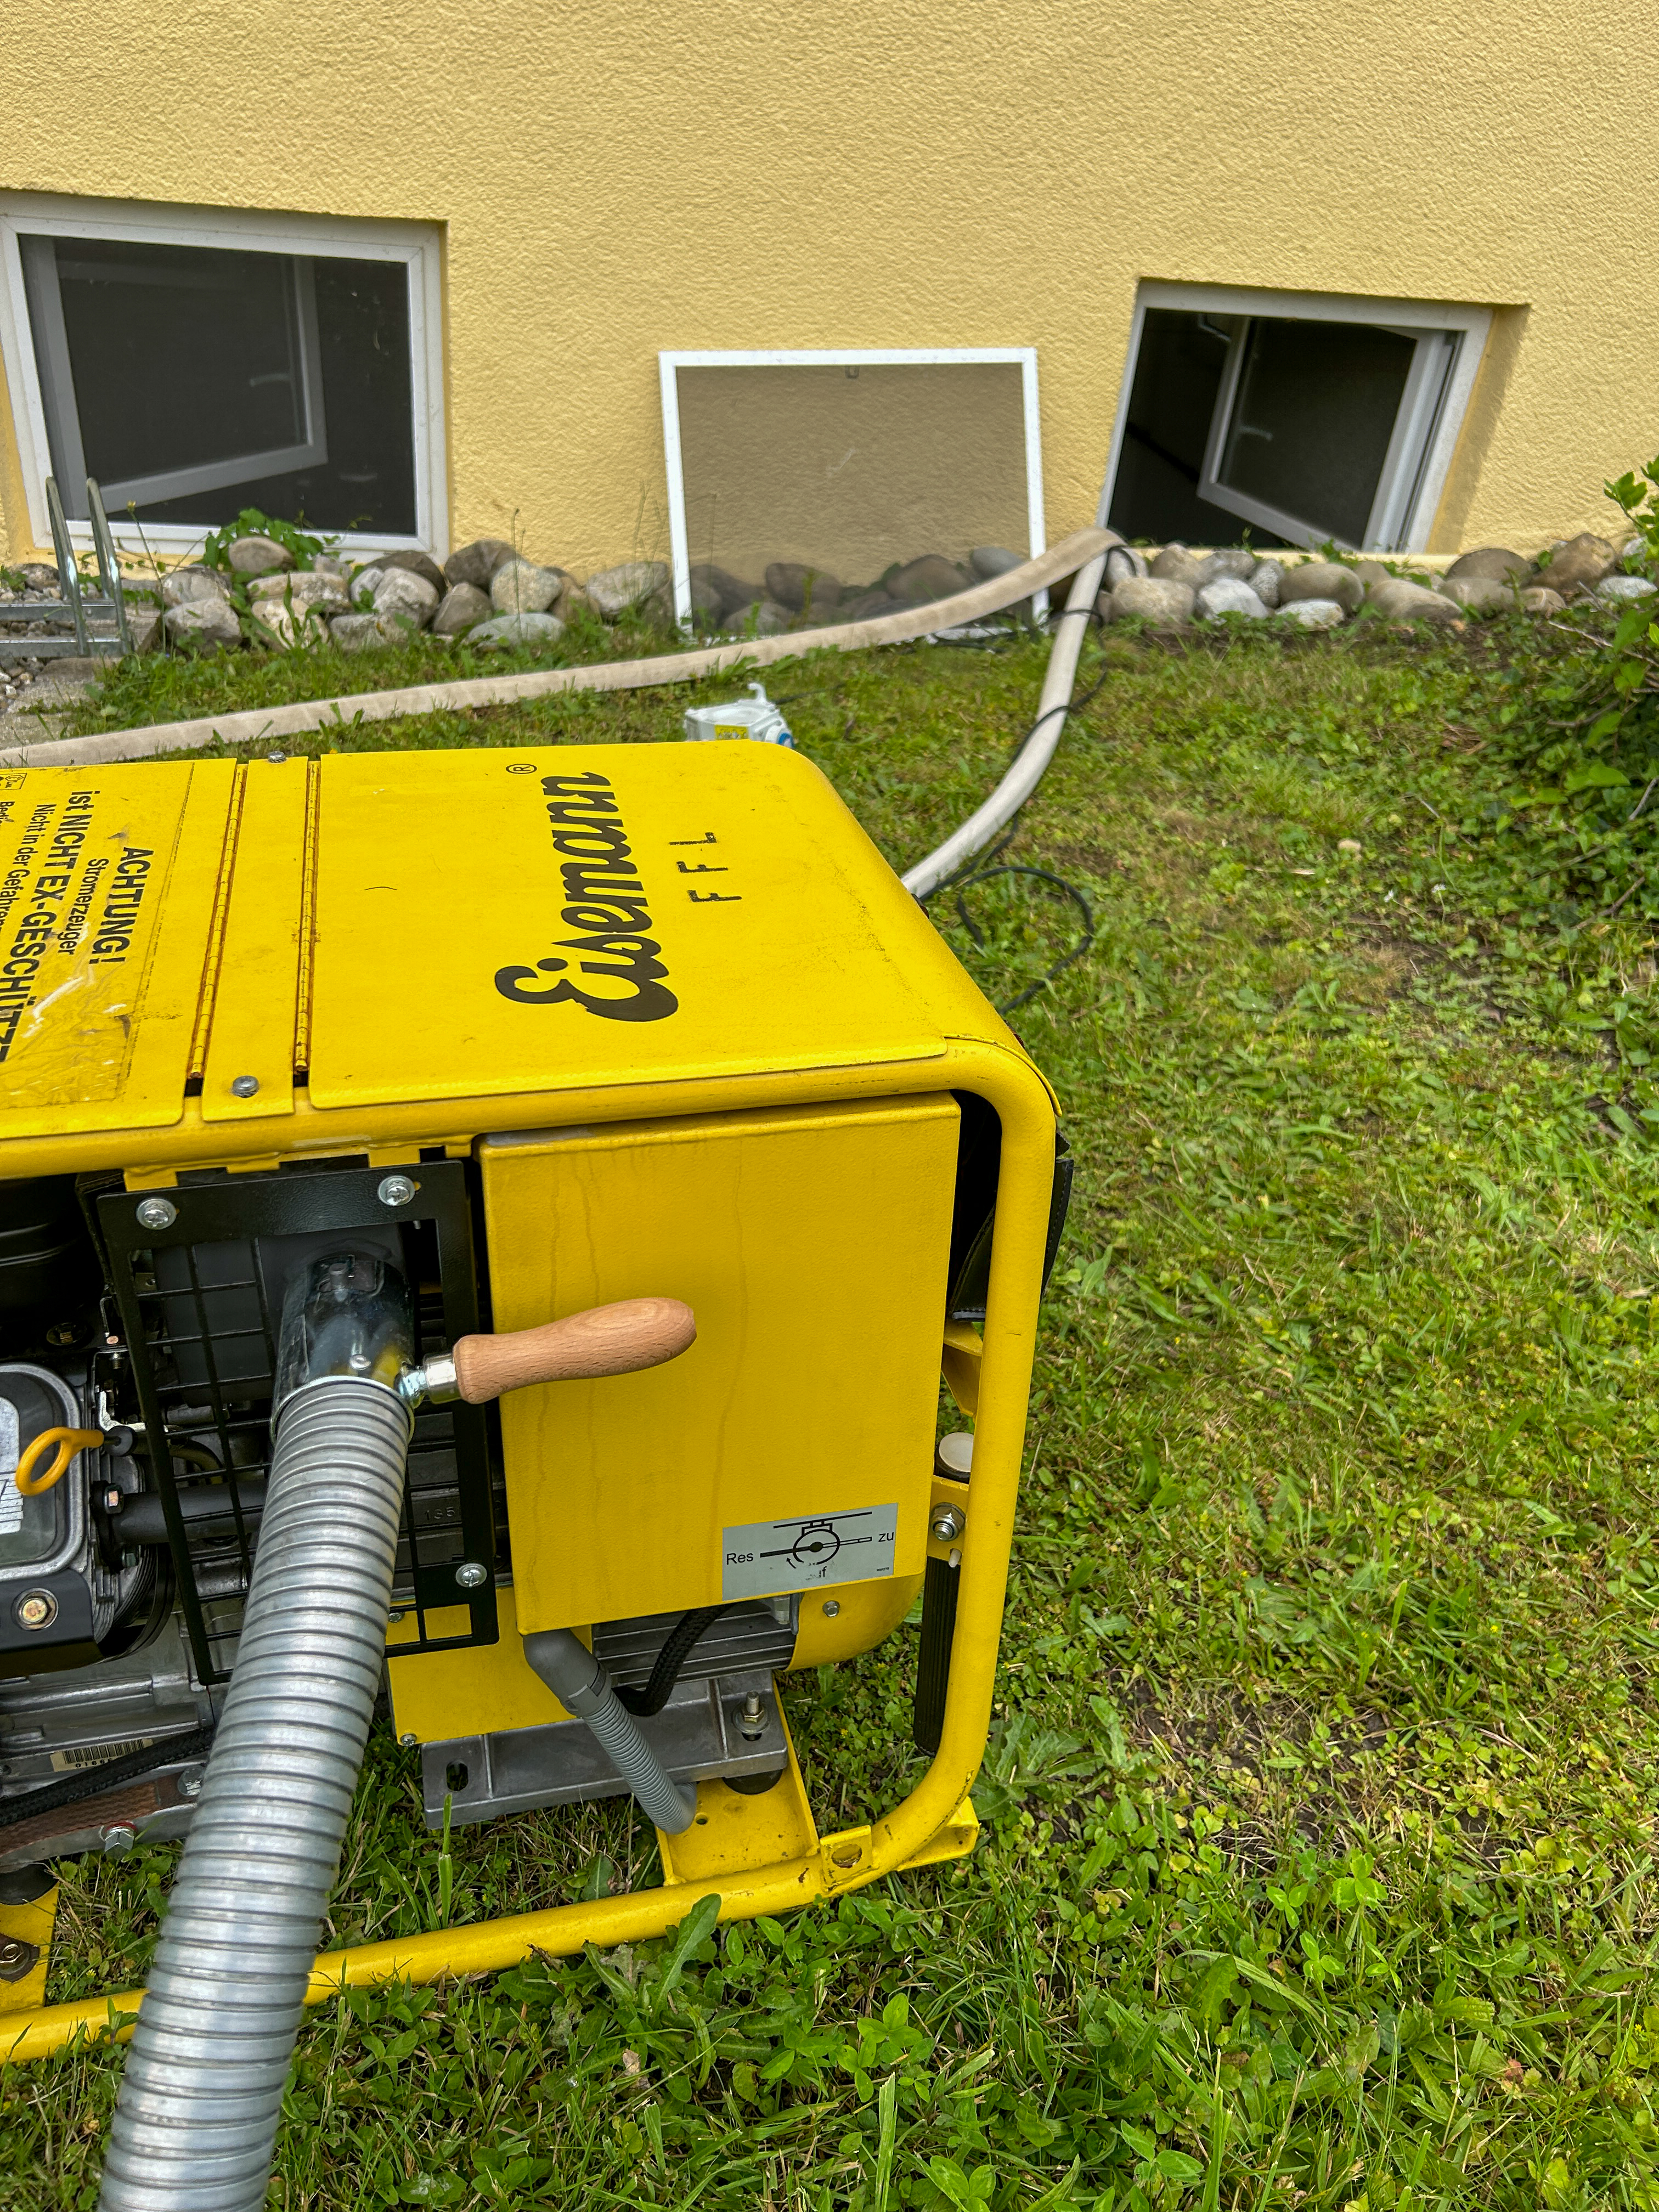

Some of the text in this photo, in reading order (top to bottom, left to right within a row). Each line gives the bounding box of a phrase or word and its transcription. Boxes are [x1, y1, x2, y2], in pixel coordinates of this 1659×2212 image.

[65, 791, 100, 811] ist
[26, 804, 57, 832] Nicht
[21, 834, 45, 844] in
[44, 814, 93, 870] NICHT
[12, 847, 39, 866] der
[57, 859, 110, 955] Stromerzeuger
[89, 847, 154, 964] ACHTUNG!
[494, 771, 679, 1022] Eisemann
[726, 1532, 894, 1565] Res zu
